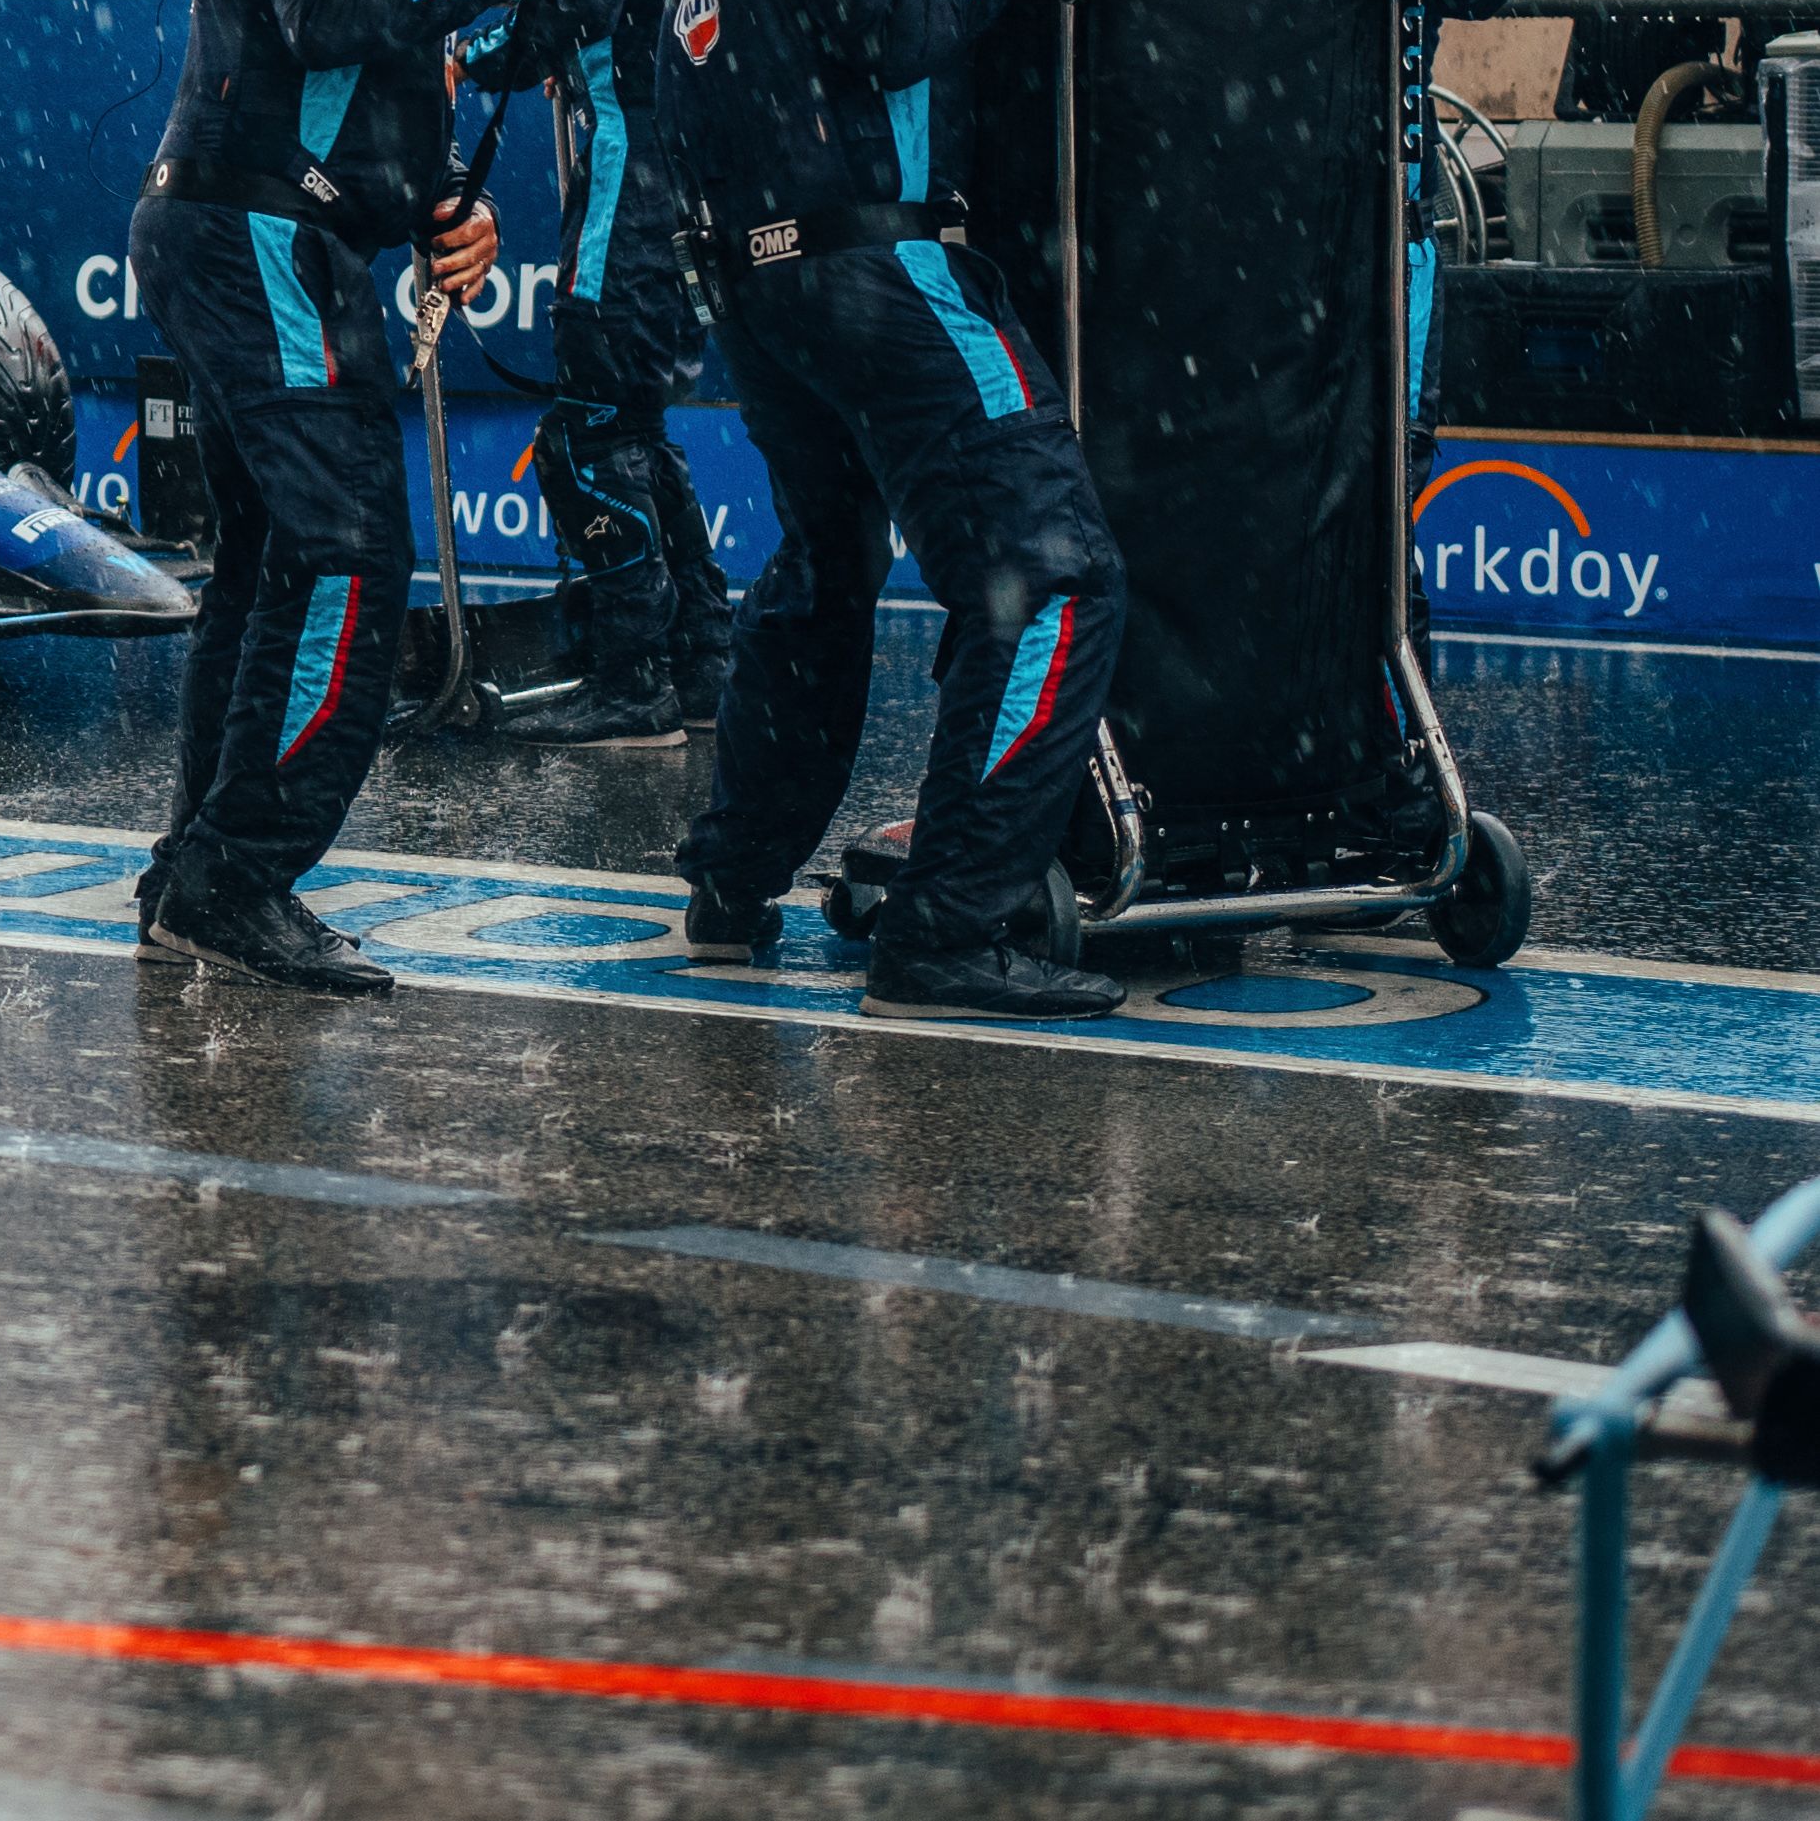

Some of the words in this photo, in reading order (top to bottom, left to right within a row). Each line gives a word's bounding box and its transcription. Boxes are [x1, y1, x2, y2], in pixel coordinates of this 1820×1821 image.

[749, 223, 800, 262] OMP
[149, 402, 173, 424] FT
[1414, 525, 1659, 617] rkday
